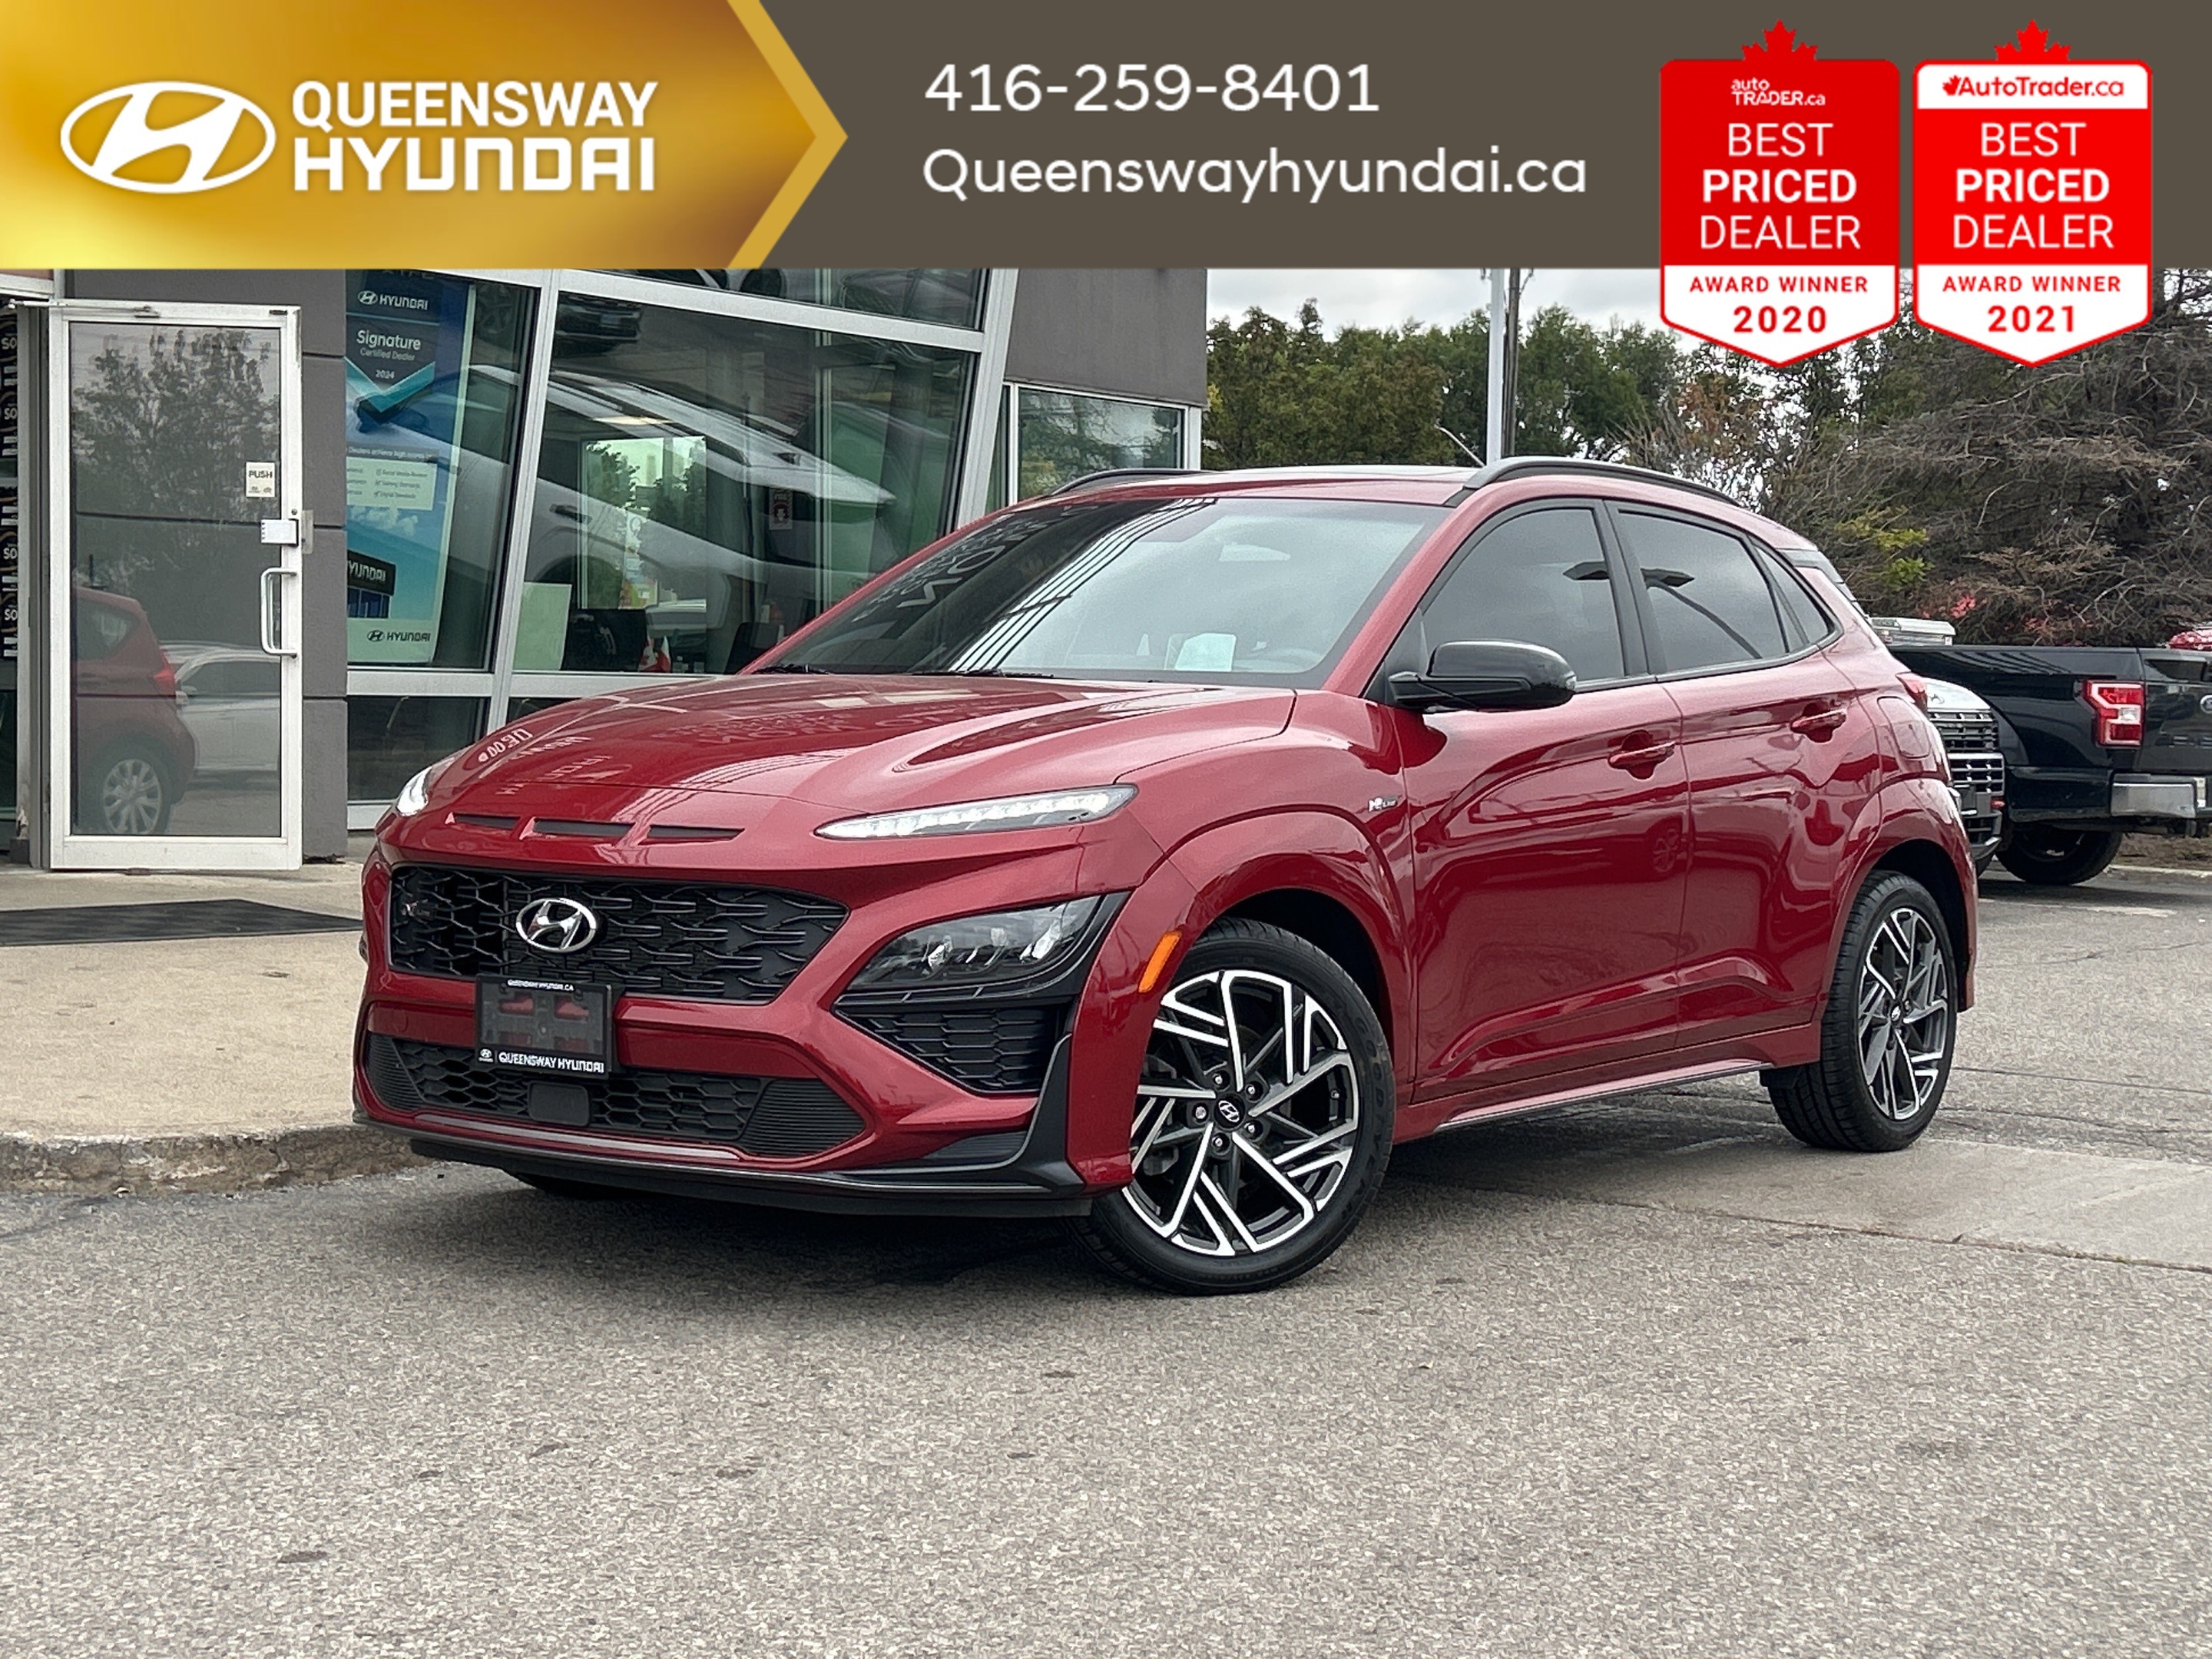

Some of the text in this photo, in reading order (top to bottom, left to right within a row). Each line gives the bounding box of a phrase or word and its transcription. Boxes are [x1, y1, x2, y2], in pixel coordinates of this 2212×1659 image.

[379, 294, 429, 310] HYUNDAI
[356, 330, 422, 350] Signature
[249, 470, 273, 478] PUSH
[386, 632, 431, 642] HYUNDAI
[498, 1051, 604, 1074] QUEENSWAY HYUNDAI
